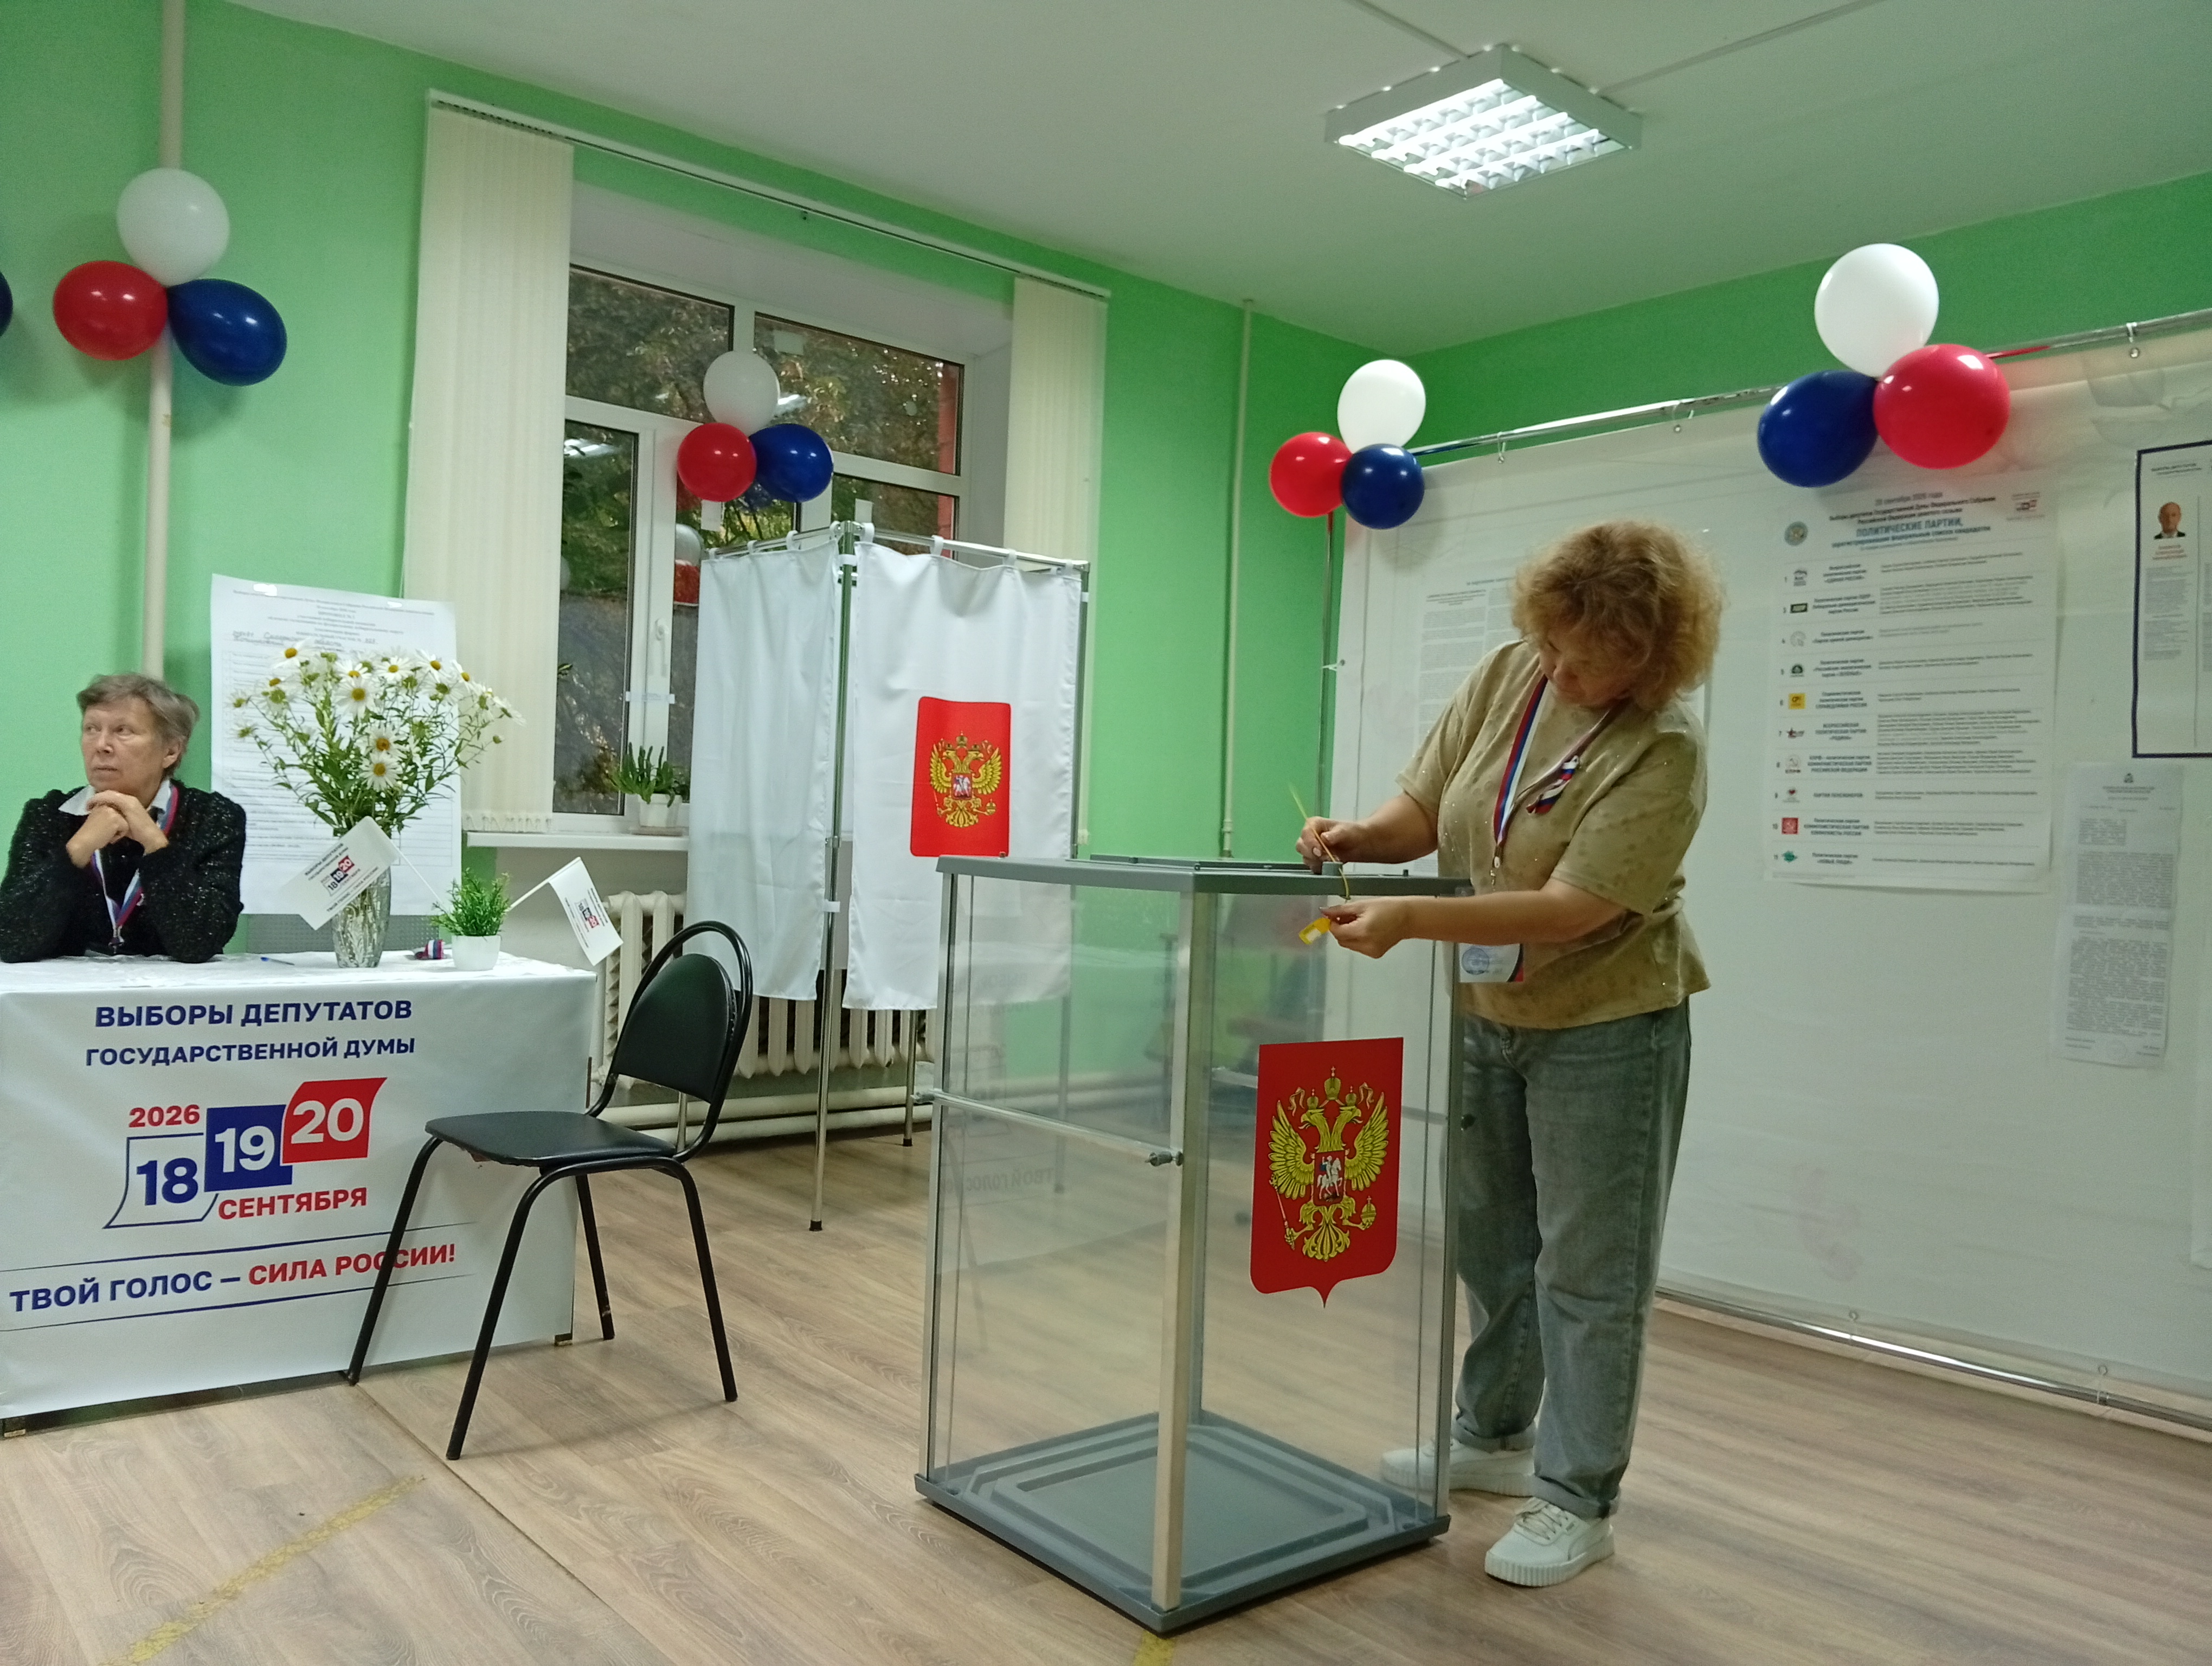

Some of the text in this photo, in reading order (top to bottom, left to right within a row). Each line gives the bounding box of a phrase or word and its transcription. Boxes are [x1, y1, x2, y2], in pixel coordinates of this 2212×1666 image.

[333, 872, 344, 881] 19
[339, 859, 352, 871] 20
[327, 881, 338, 891] 18
[95, 1000, 413, 1028] ВЫБОРЫ ДЕПУТАТОВ
[86, 1037, 415, 1066] ГОСУДАРСТВЕННОЙ ДУМЫ
[128, 1104, 200, 1128] 2026
[291, 1098, 364, 1144] 20
[215, 1126, 275, 1172] 19
[136, 1158, 199, 1206] 18
[218, 1188, 367, 1220] СЕНТЯБРЯ
[10, 1278, 99, 1312] ТВОЙ
[110, 1271, 212, 1301] ГОЛОС
[249, 1259, 326, 1285] СИЛА
[336, 1244, 455, 1276] РОССИИ!
